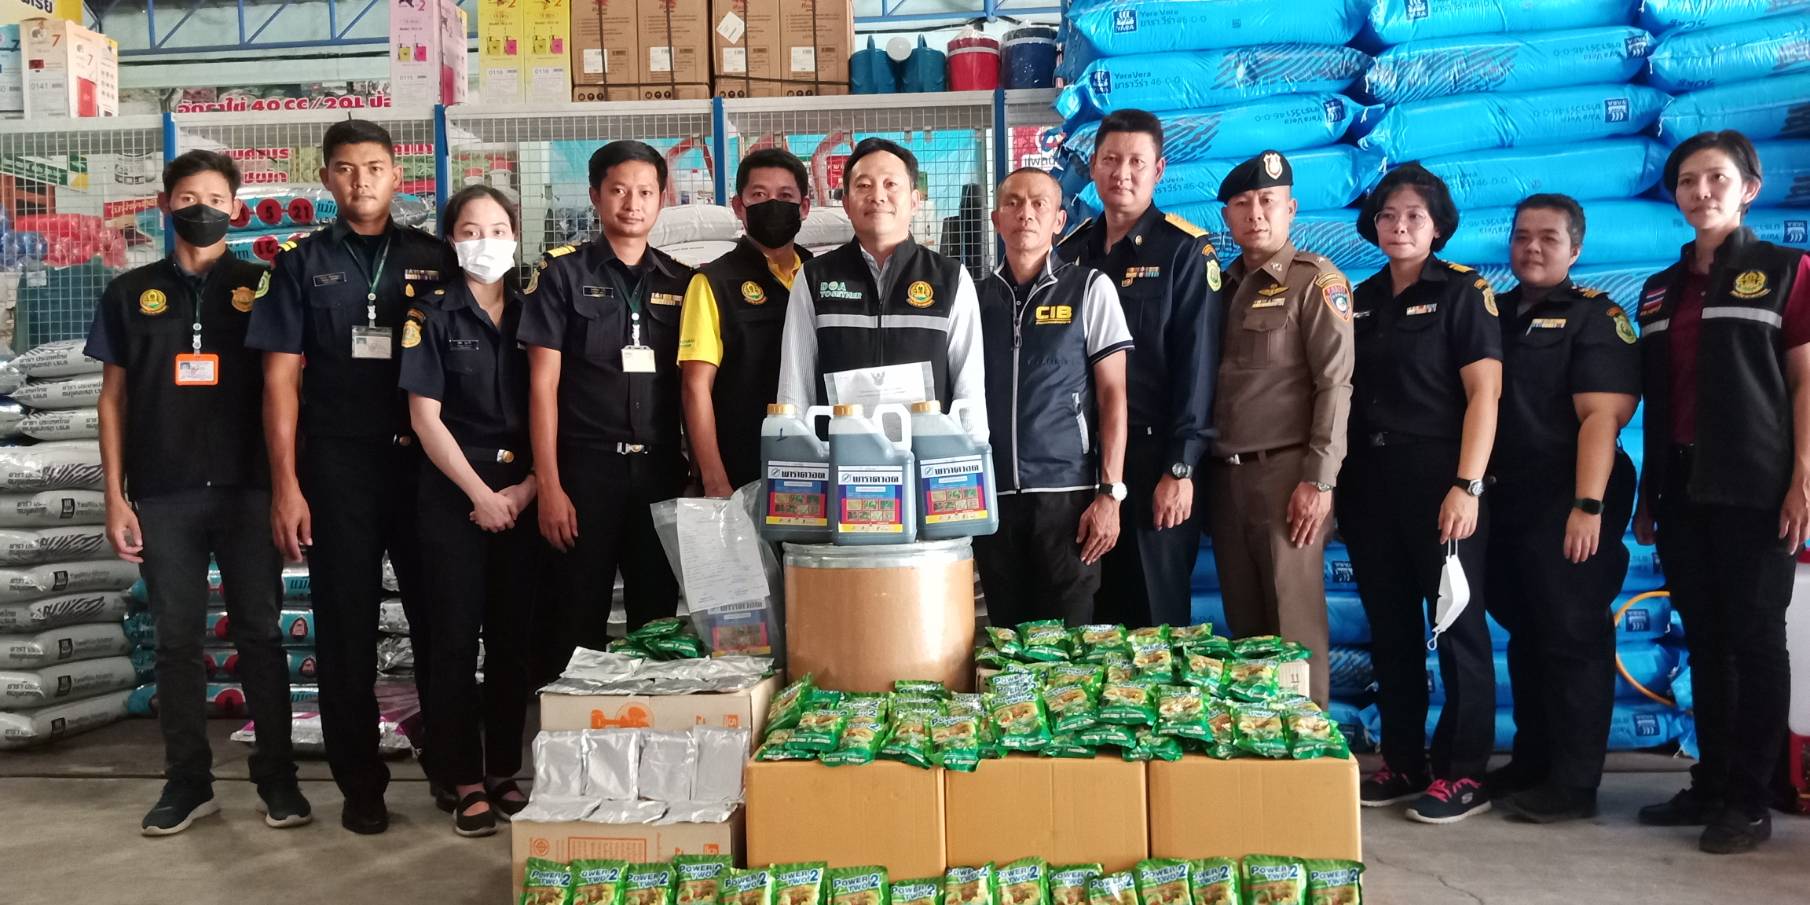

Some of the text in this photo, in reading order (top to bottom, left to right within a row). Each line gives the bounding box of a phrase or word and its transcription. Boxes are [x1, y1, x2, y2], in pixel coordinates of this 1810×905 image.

[52, 34, 60, 47] 7
[251, 100, 280, 111] 40
[266, 206, 310, 218] 5 21
[820, 281, 847, 291] DOA
[820, 290, 862, 300] TOGETHER
[1035, 305, 1073, 319] CIB
[608, 868, 618, 880] 2
[680, 864, 712, 873] POWER
[1029, 866, 1039, 878] 2
[1142, 864, 1187, 878] POWER 2
[1220, 866, 1229, 879] 2
[1251, 865, 1298, 877] POWER 2
[1312, 868, 1357, 881] POWER 2
[532, 870, 571, 886] POWER 2
[659, 872, 668, 885] 2
[725, 872, 768, 887] POWER 2
[809, 869, 819, 881] 2
[833, 874, 879, 888] POWER 2
[891, 884, 936, 895] POWER 2
